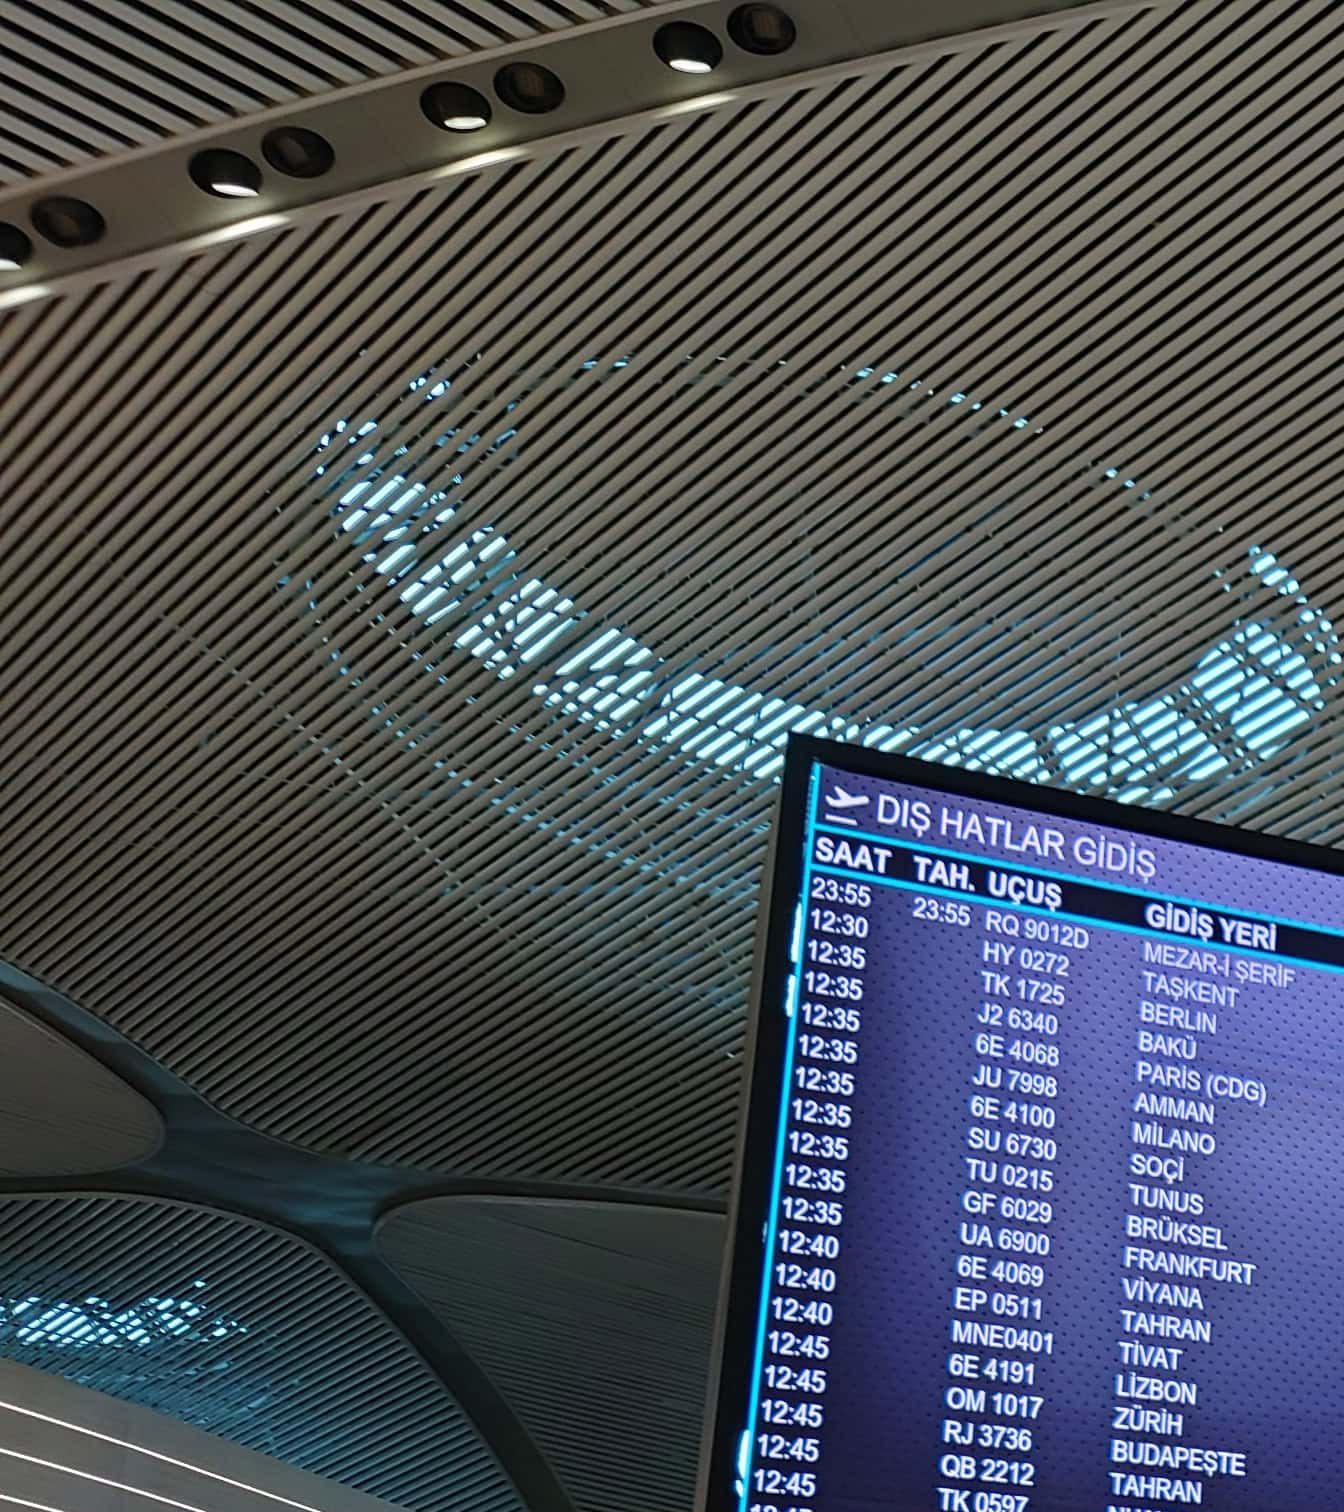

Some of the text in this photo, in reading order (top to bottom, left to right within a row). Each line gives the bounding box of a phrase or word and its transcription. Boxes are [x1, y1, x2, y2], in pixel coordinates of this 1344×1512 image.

[877, 793, 930, 837] DIŞ
[940, 807, 1064, 860] HATLAR
[1073, 834, 1155, 883] GİDİŞ
[811, 876, 870, 907] 23:55
[912, 896, 970, 926] 23:55
[985, 909, 1019, 937] RQ
[1024, 918, 1088, 948] 9012D
[1144, 941, 1229, 976] MEZAR-İ
[1234, 959, 1295, 987] ŞERİF
[815, 836, 892, 873] SAAT
[913, 855, 975, 891] TAH.
[988, 871, 1061, 911] UÇUŞ
[1146, 903, 1213, 941] GİDİŞ
[1219, 917, 1276, 950] YERİ
[805, 970, 863, 1000] 12:35
[977, 1002, 1002, 1025] J2
[1007, 1007, 1057, 1034] 6340
[1138, 1030, 1196, 1059] BAKÜ
[771, 1296, 832, 1325] 12:40
[952, 1319, 1053, 1354] MNE0401
[1118, 1340, 1183, 1370] TİVAT
